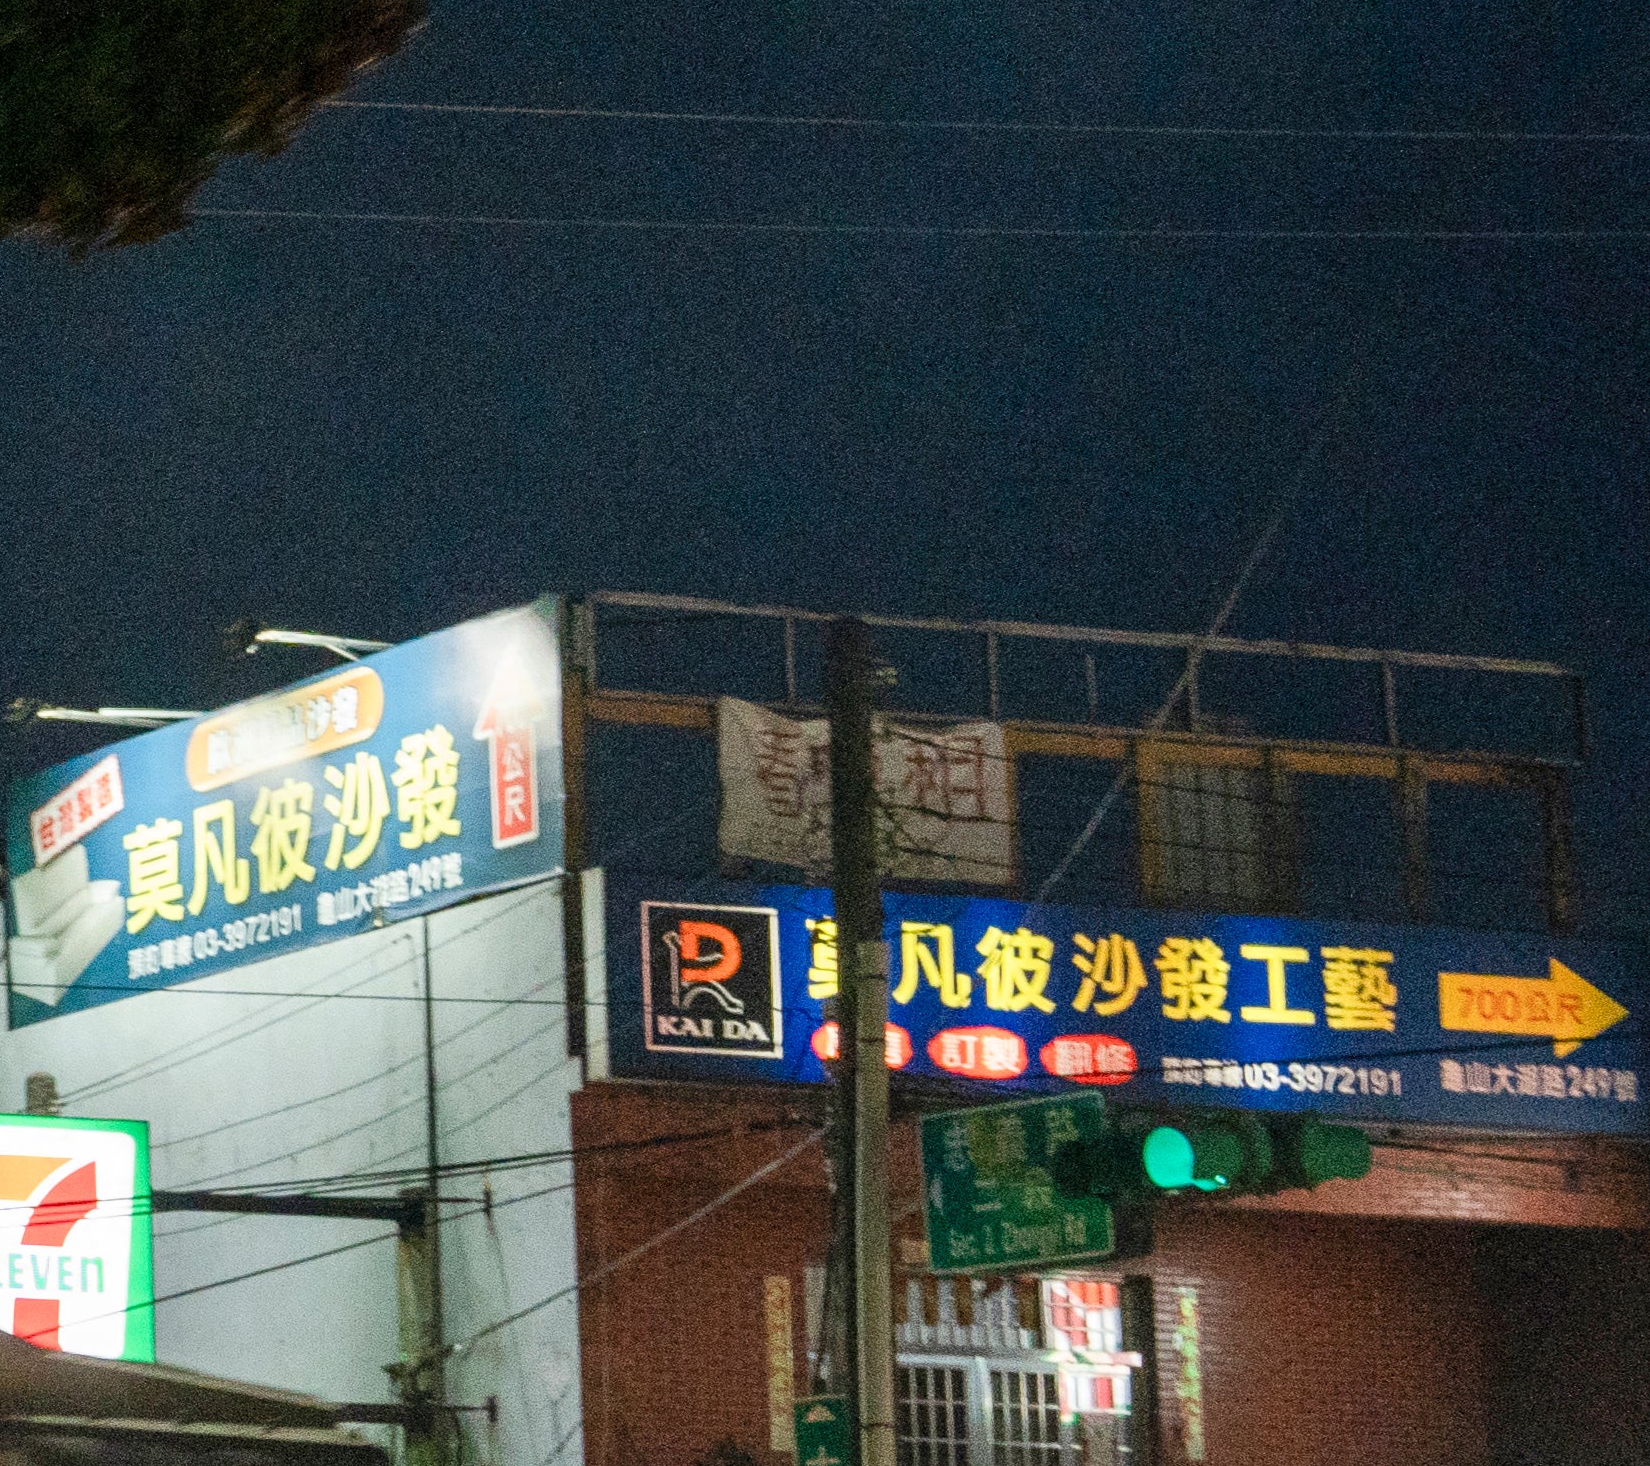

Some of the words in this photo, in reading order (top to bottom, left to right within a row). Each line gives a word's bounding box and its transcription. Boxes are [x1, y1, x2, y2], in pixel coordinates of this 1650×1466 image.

[123, 724, 461, 935] 莫凡彼沙發
[657, 1015, 714, 1040] KAI
[722, 1019, 770, 1043] DA
